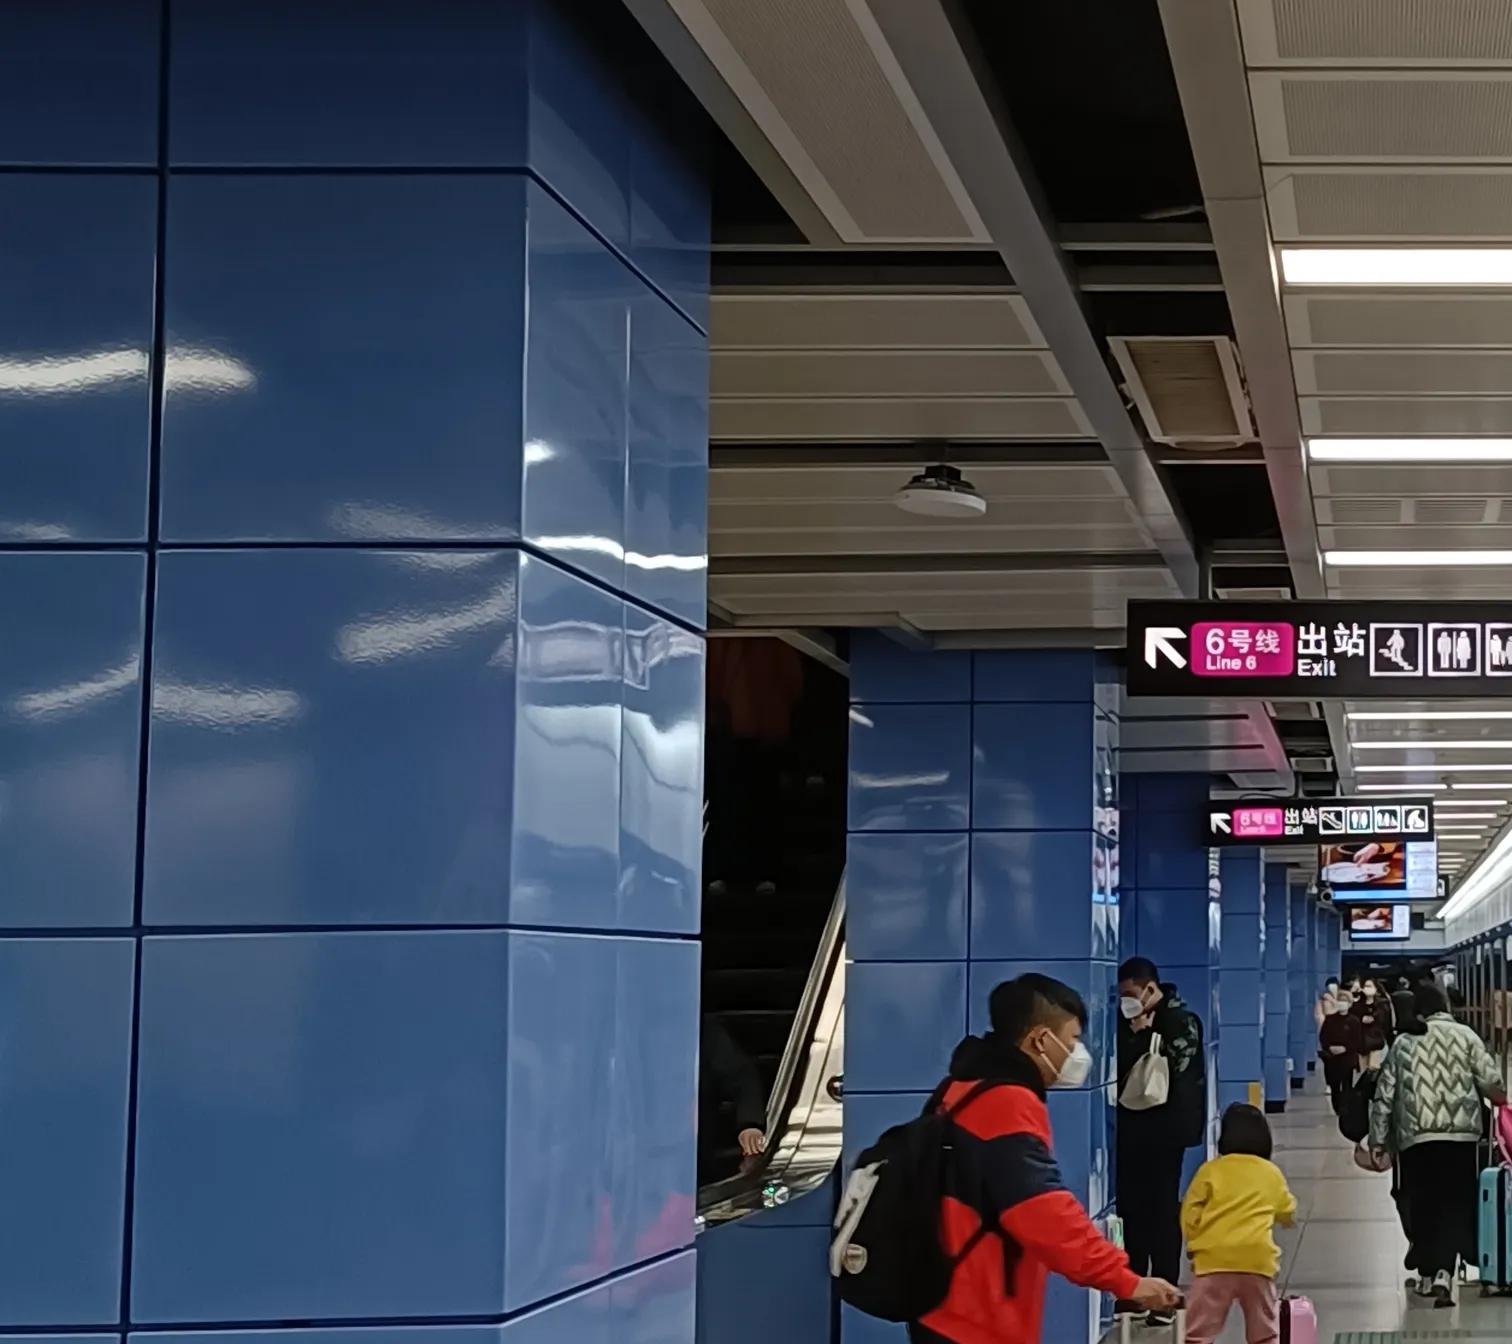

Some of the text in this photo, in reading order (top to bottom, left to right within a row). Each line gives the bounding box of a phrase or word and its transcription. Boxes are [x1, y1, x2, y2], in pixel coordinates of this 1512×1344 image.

[1205, 628, 1280, 655] 6号线
[1297, 621, 1367, 657] 出站
[1205, 655, 1257, 671] Line 6
[1297, 657, 1337, 676] Exit
[1284, 807, 1318, 825] 出站
